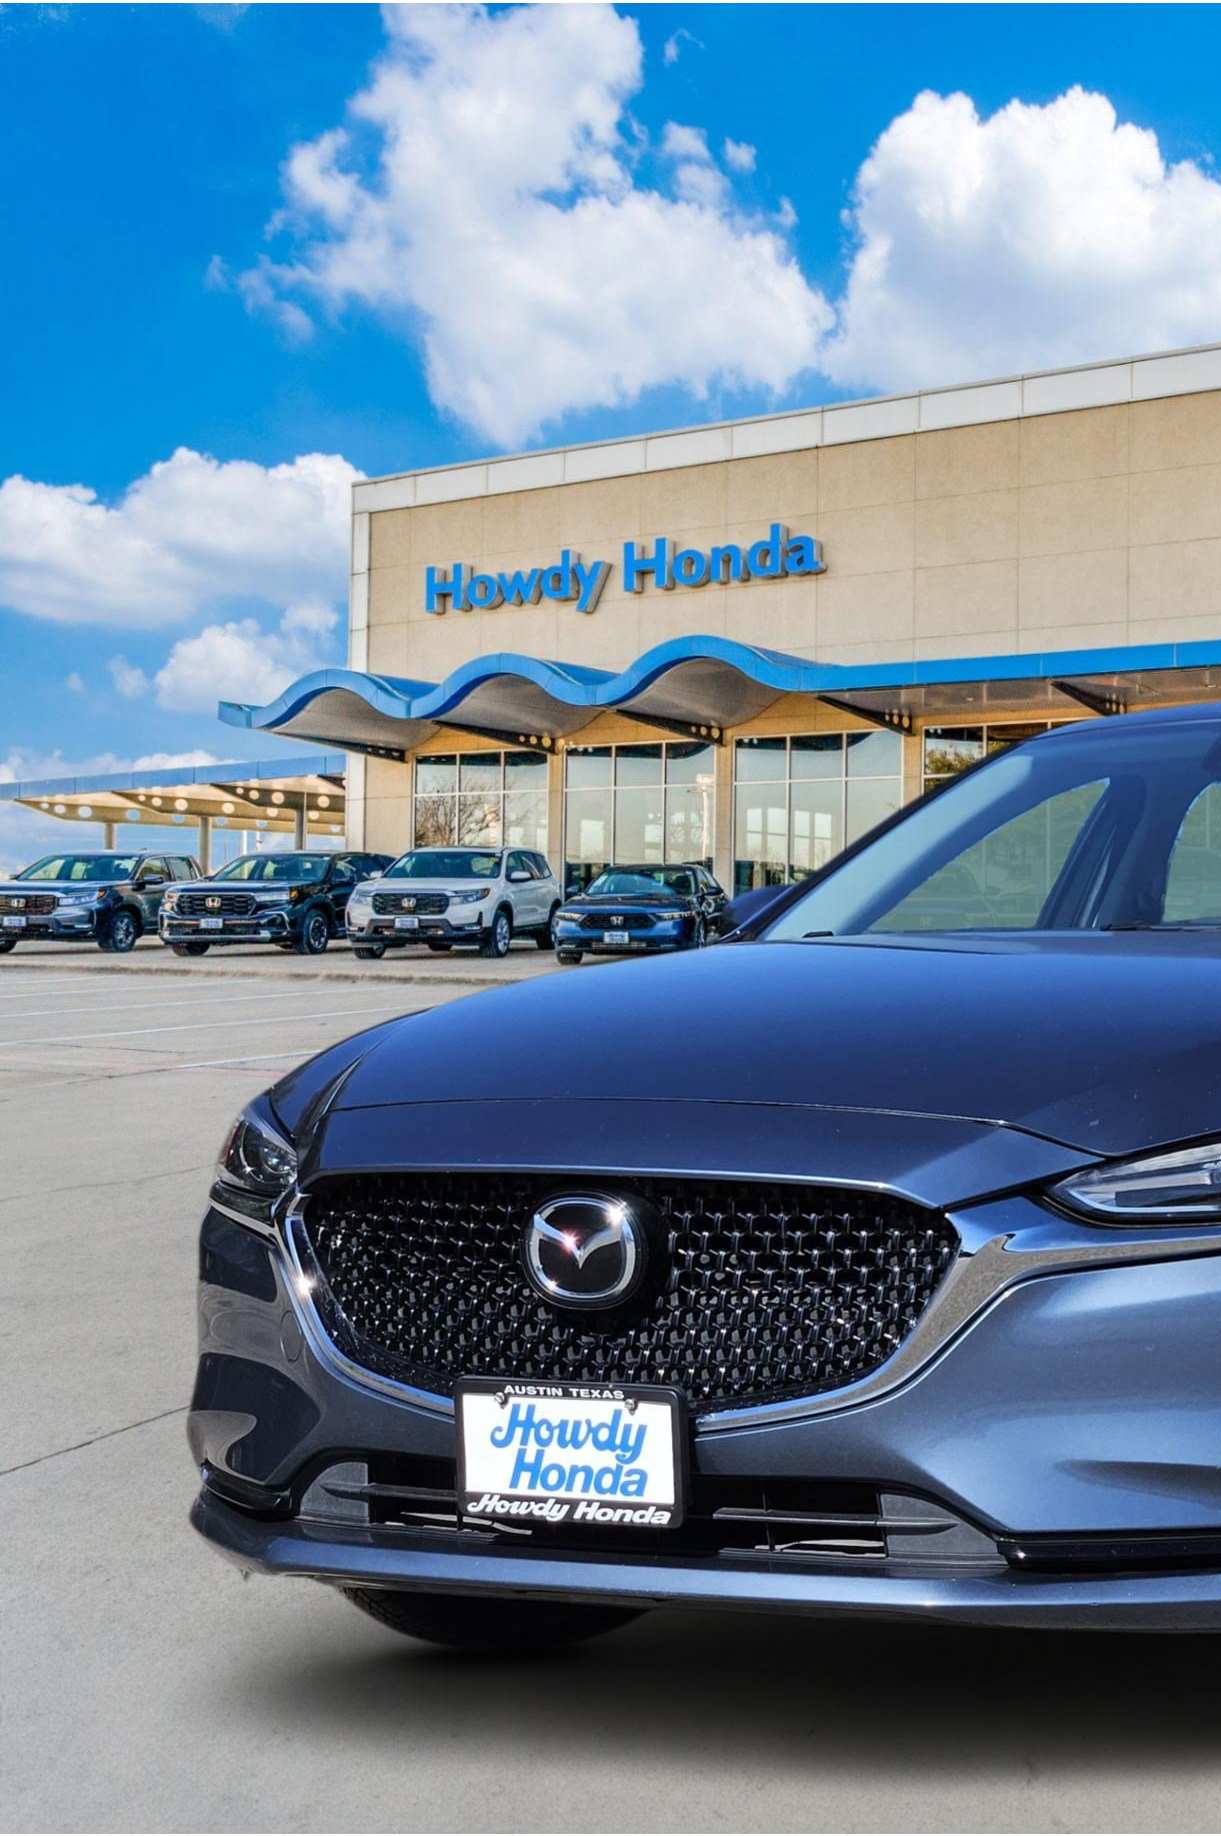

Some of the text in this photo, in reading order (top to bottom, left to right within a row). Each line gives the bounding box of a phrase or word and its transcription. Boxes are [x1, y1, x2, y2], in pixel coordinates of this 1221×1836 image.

[425, 523, 827, 615] Howdy Honda
[503, 1384, 625, 1400] AUSTIN TEXAS
[490, 1403, 648, 1465] Howdy
[509, 1447, 649, 1497] Honda
[467, 1494, 673, 1525] Howdy Honda
